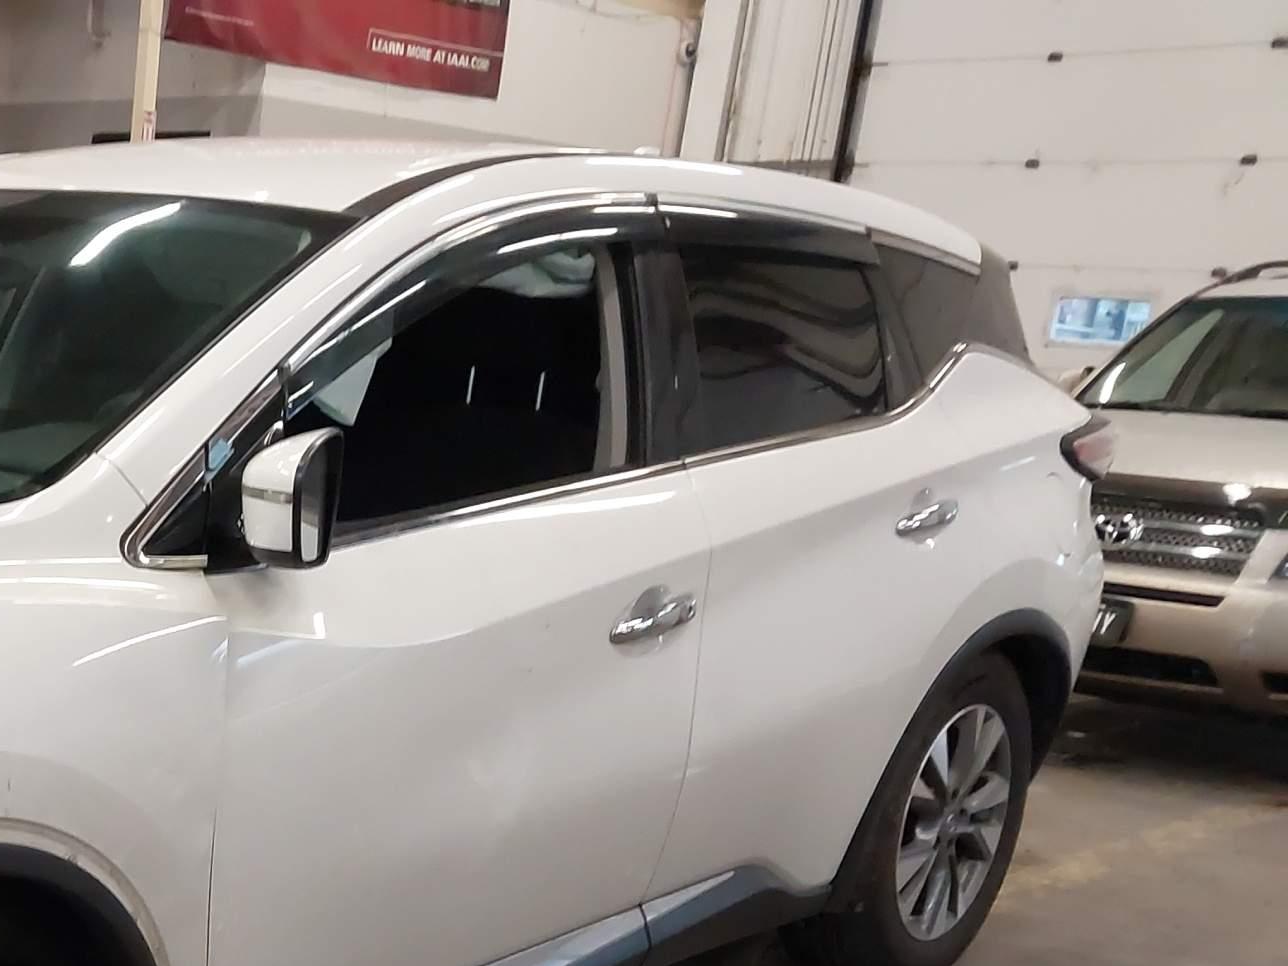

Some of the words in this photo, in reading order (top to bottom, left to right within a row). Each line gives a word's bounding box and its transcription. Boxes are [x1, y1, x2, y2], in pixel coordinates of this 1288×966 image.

[371, 37, 404, 56] LEARN
[407, 44, 432, 62] MORE
[432, 50, 445, 65] AT
